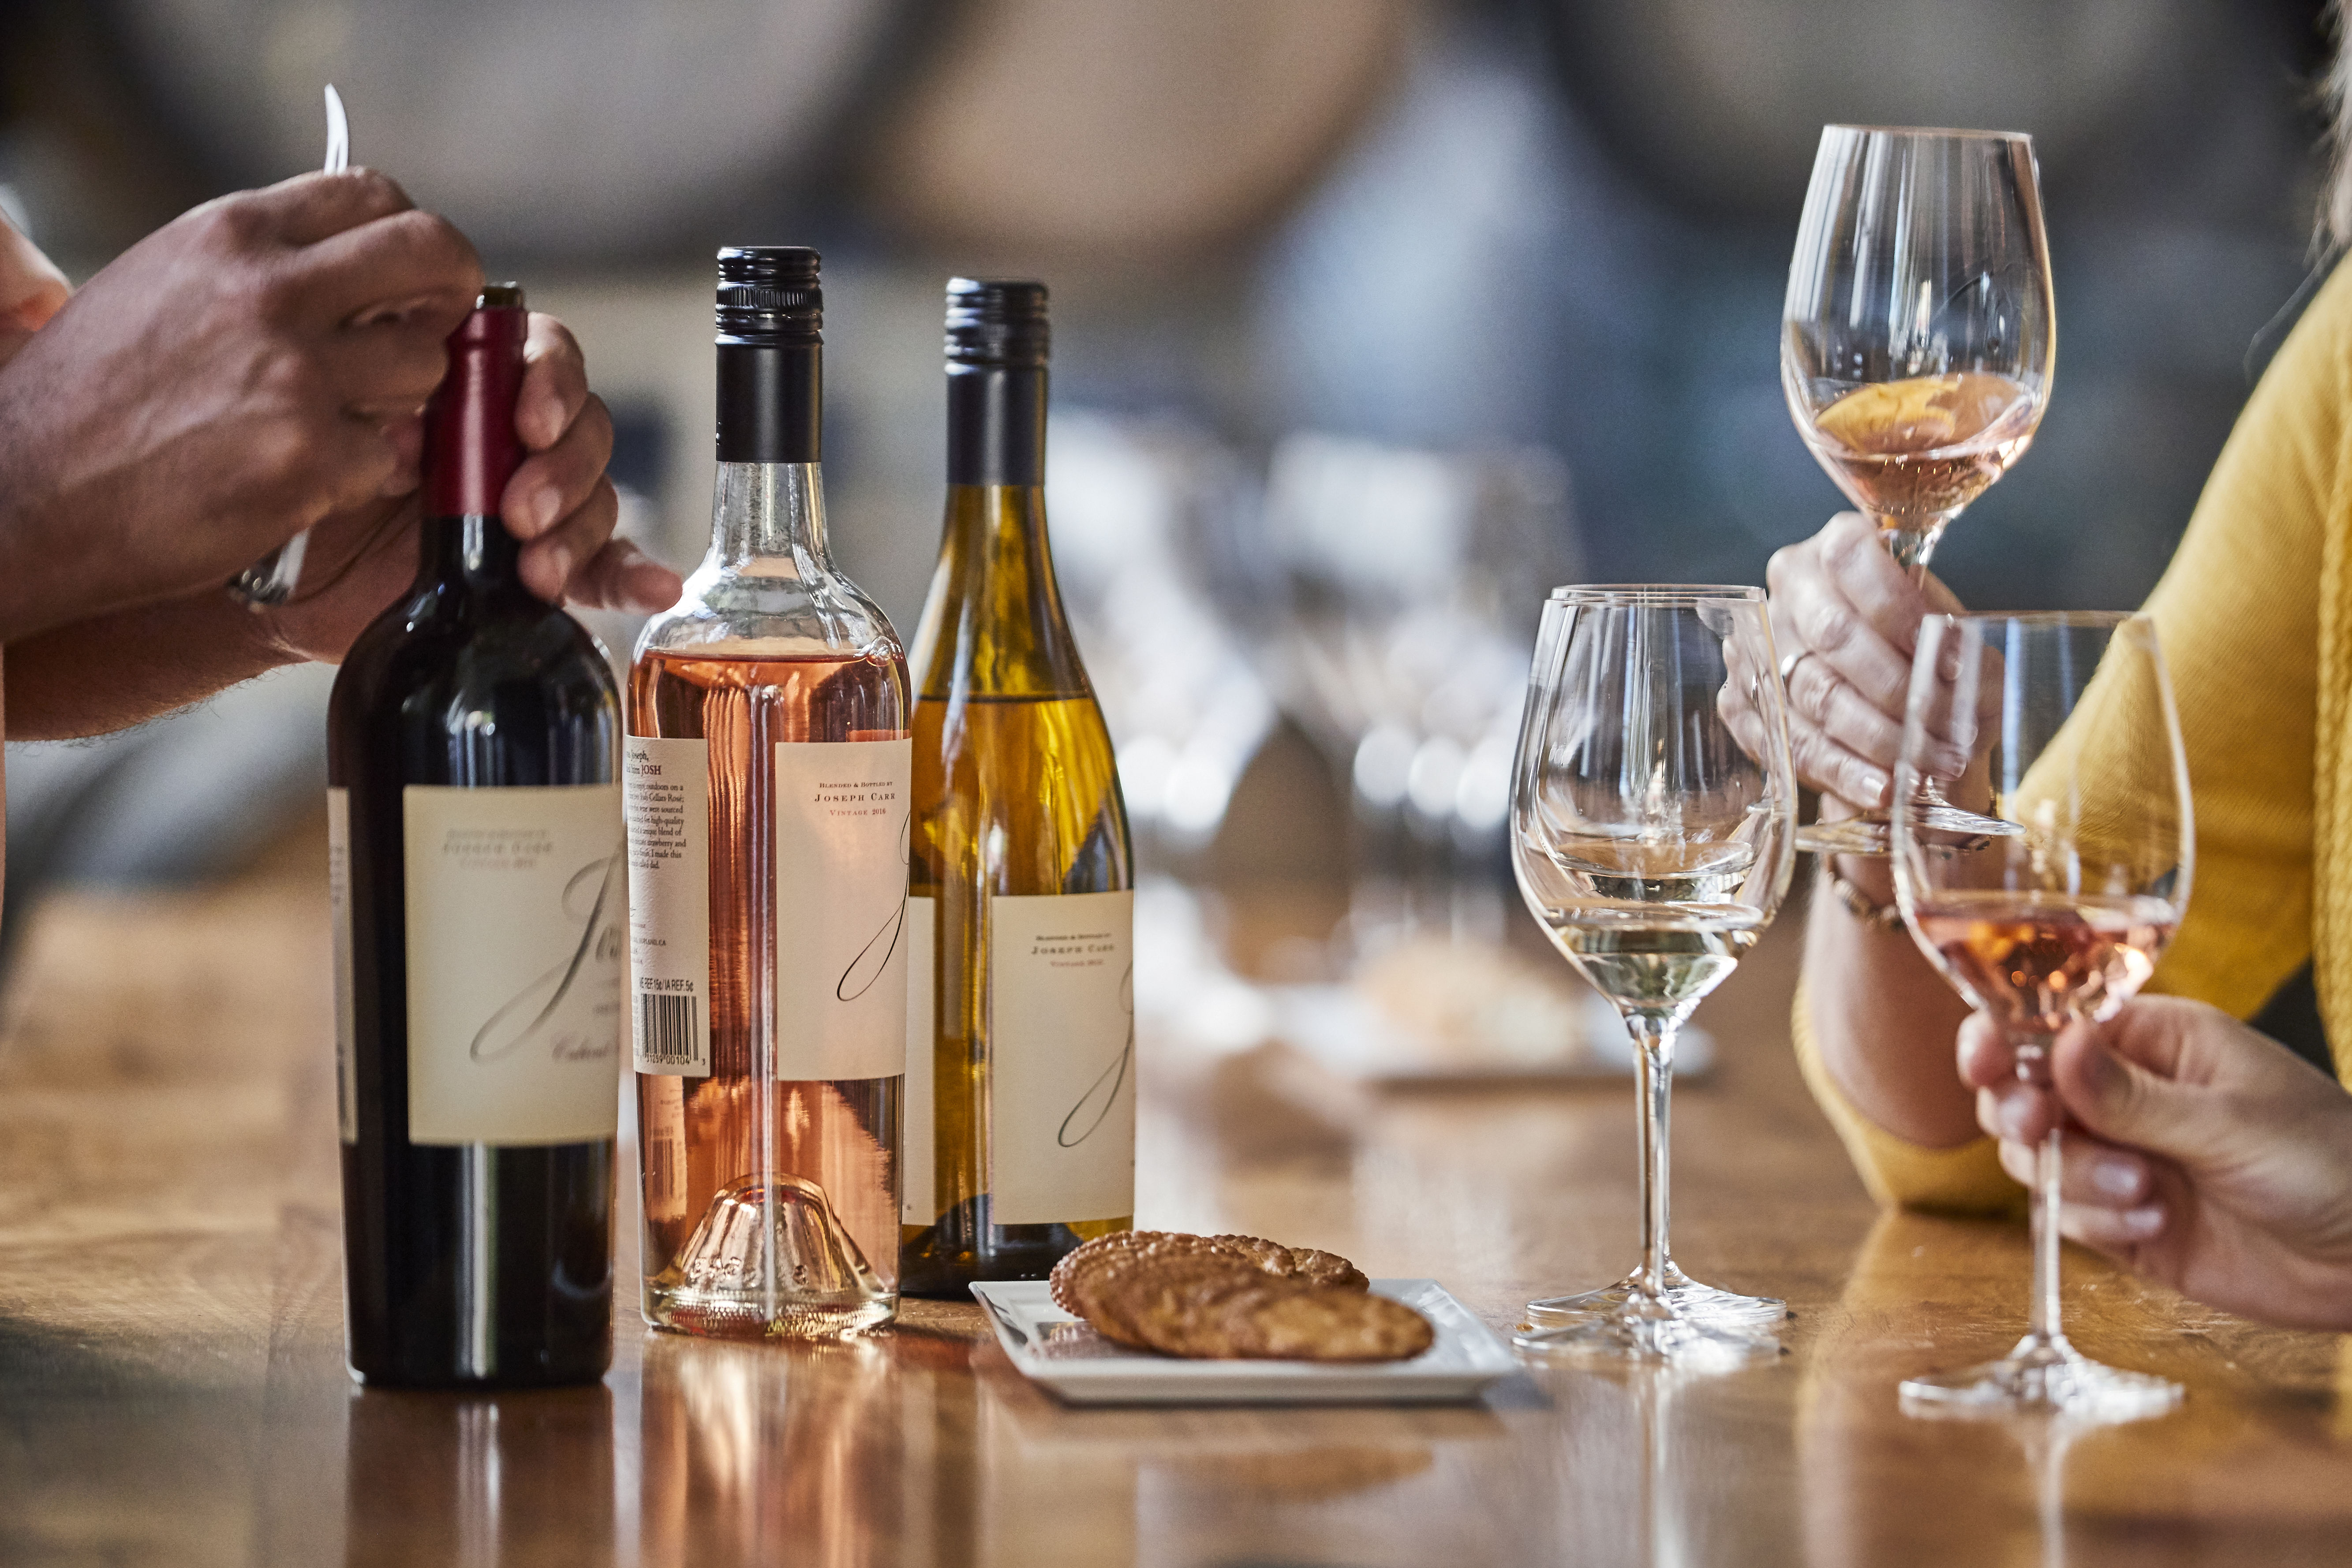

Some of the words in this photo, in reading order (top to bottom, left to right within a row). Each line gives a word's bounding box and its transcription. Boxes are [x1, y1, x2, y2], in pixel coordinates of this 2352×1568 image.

[631, 750, 649, 762] Joseph,
[641, 764, 662, 777] JOSH
[649, 793, 667, 802] Cellars
[814, 794, 865, 802] JOSEPH
[871, 792, 895, 801] CARR
[661, 804, 683, 814] sourced
[651, 816, 684, 829] high-quality
[658, 827, 673, 836] blend
[675, 839, 686, 847] and
[655, 849, 669, 858] made
[670, 850, 681, 858] this
[666, 1055, 690, 1065] 00104
